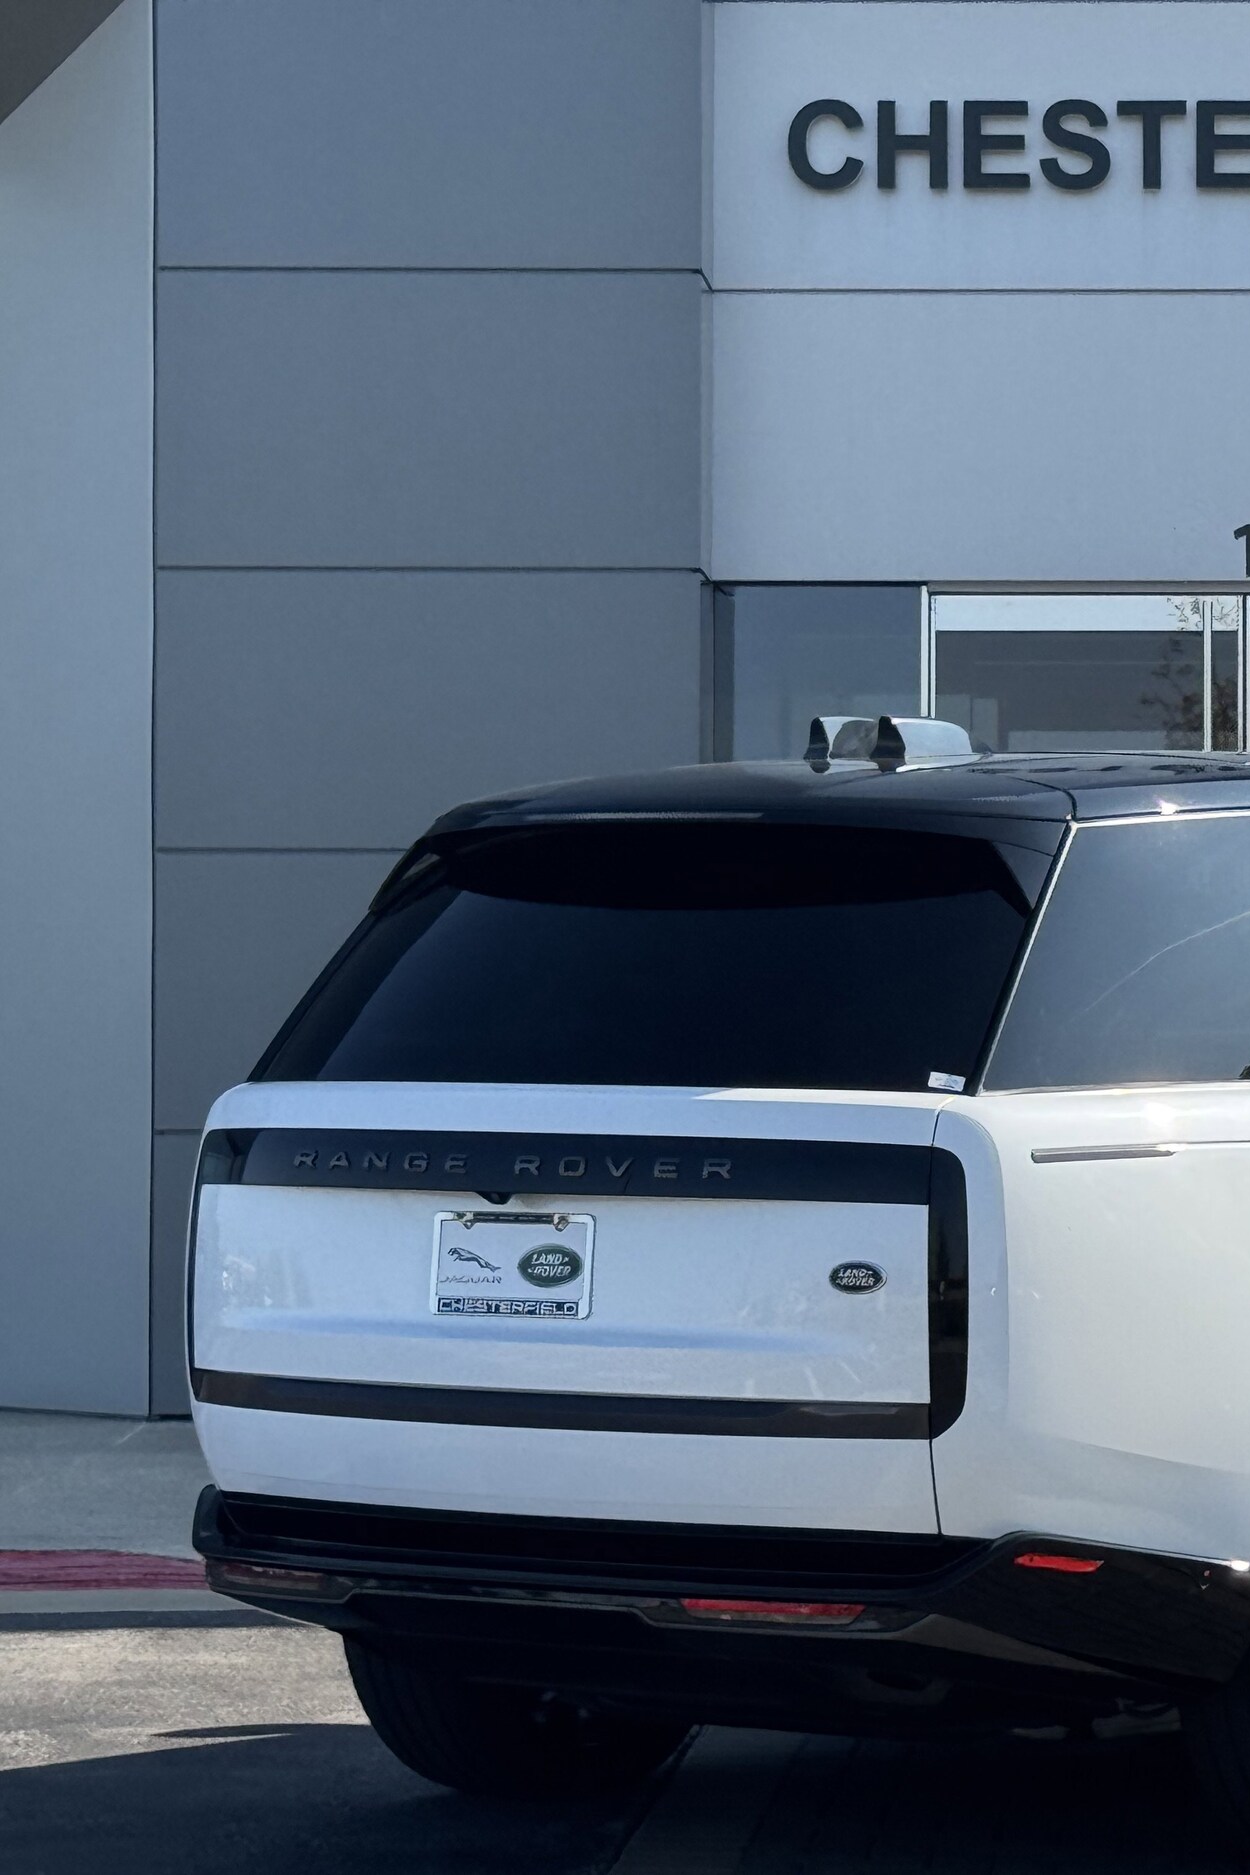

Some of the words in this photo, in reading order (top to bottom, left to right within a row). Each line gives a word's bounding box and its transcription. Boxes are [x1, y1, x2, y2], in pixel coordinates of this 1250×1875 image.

[293, 1150, 469, 1174] RANGE
[513, 1154, 733, 1180] ROVER
[531, 1253, 563, 1265] LAND
[533, 1265, 572, 1277] ROVER
[838, 1268, 867, 1277] LAND
